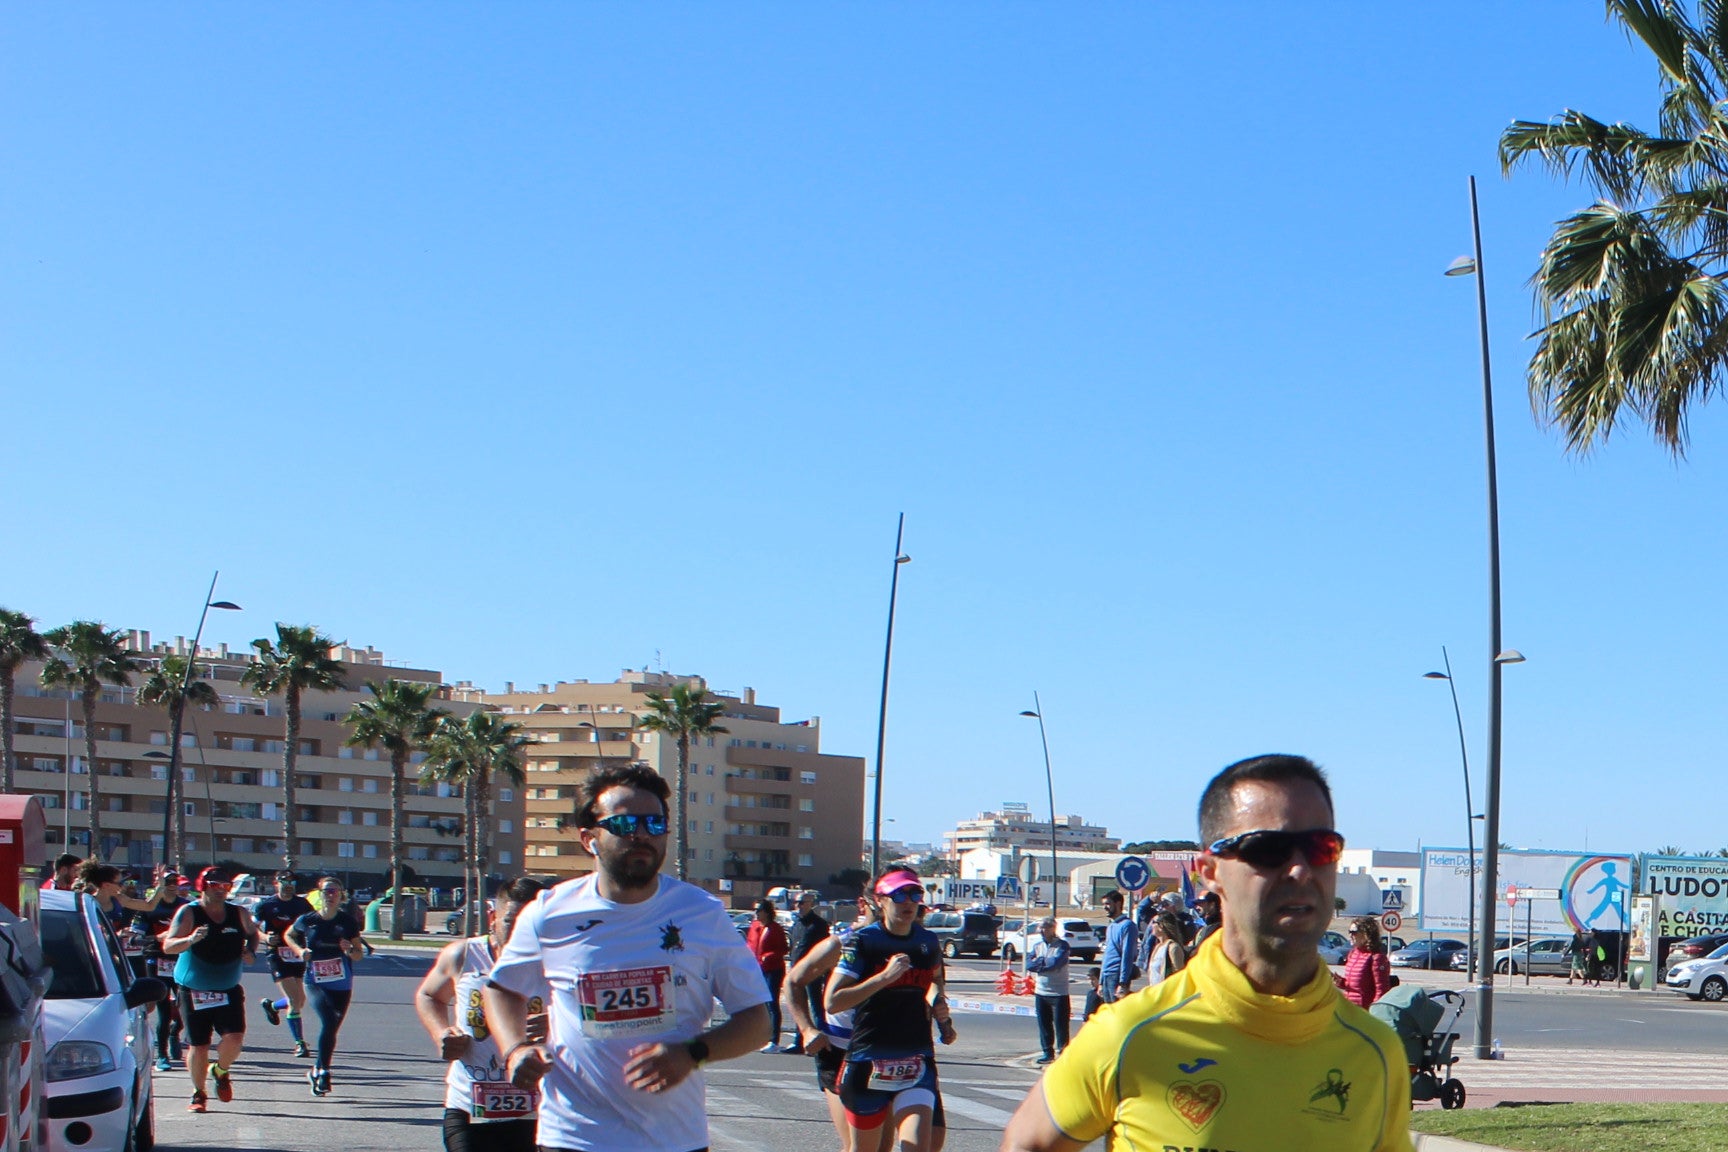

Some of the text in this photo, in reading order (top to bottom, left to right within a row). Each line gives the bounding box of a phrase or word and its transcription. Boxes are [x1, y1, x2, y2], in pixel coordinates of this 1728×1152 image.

[1429, 854, 1456, 866] Helen
[1649, 864, 1684, 874] CENTRO
[1685, 866, 1697, 874] DE
[1385, 917, 1397, 926] 40
[602, 986, 651, 1011] 245
[490, 1095, 528, 1111] 252
